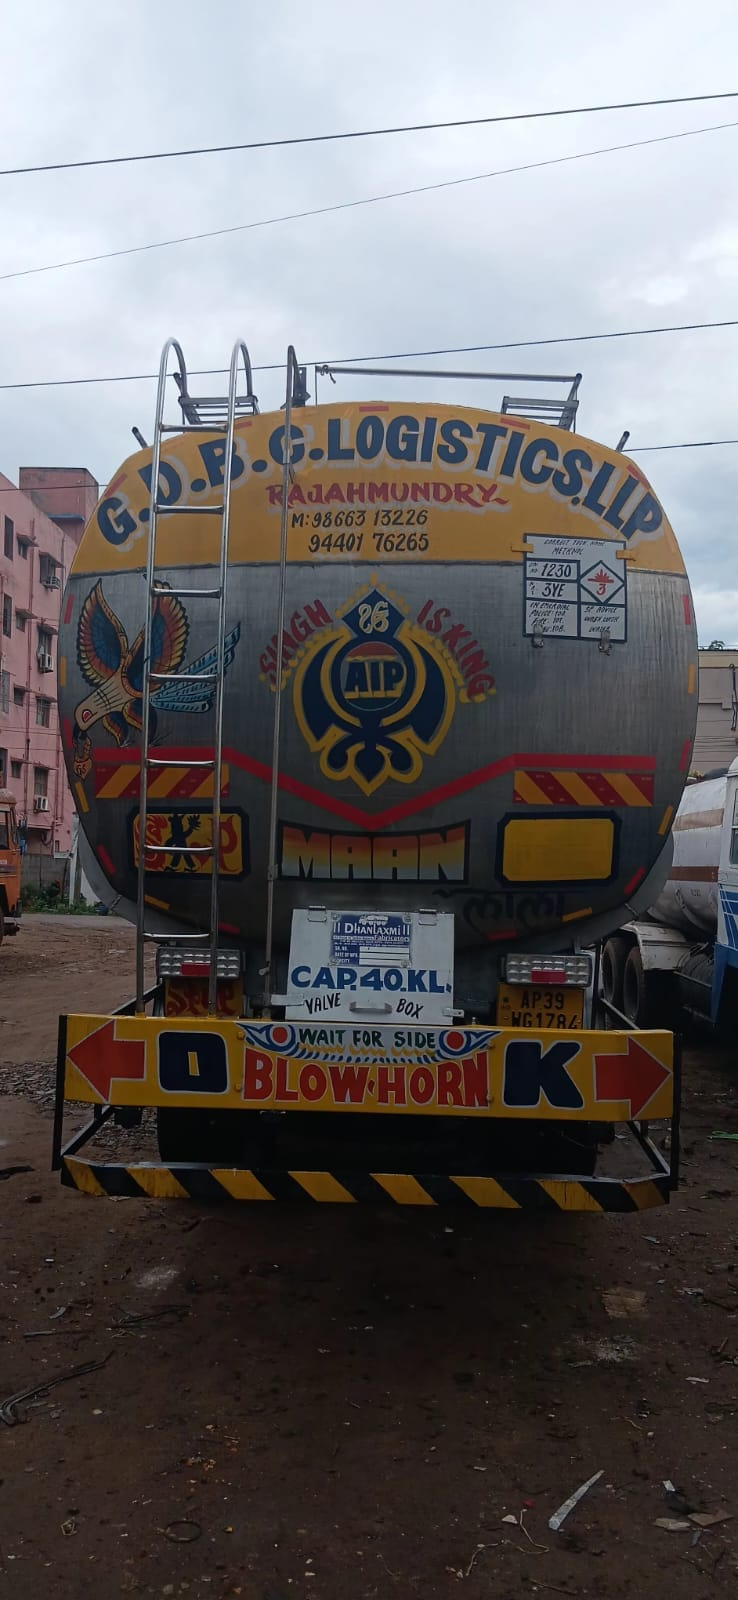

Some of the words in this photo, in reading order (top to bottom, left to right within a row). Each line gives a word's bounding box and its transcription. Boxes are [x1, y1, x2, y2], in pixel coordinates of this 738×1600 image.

[373, 509, 429, 526] 13226
[307, 532, 364, 553] 94401
[371, 532, 430, 552] 76265
[541, 563, 572, 578] 1230
[541, 582, 566, 598] 3YE
[596, 583, 607, 596] 3
[258, 598, 334, 689] SINGH
[344, 659, 405, 695] AIP
[304, 993, 341, 1014] VALVE
[396, 998, 424, 1019] BOX
[520, 991, 565, 1010] AP39
[299, 1029, 346, 1046] WAIT
[352, 1030, 387, 1047] FOR
[395, 1030, 437, 1049] SIDE
